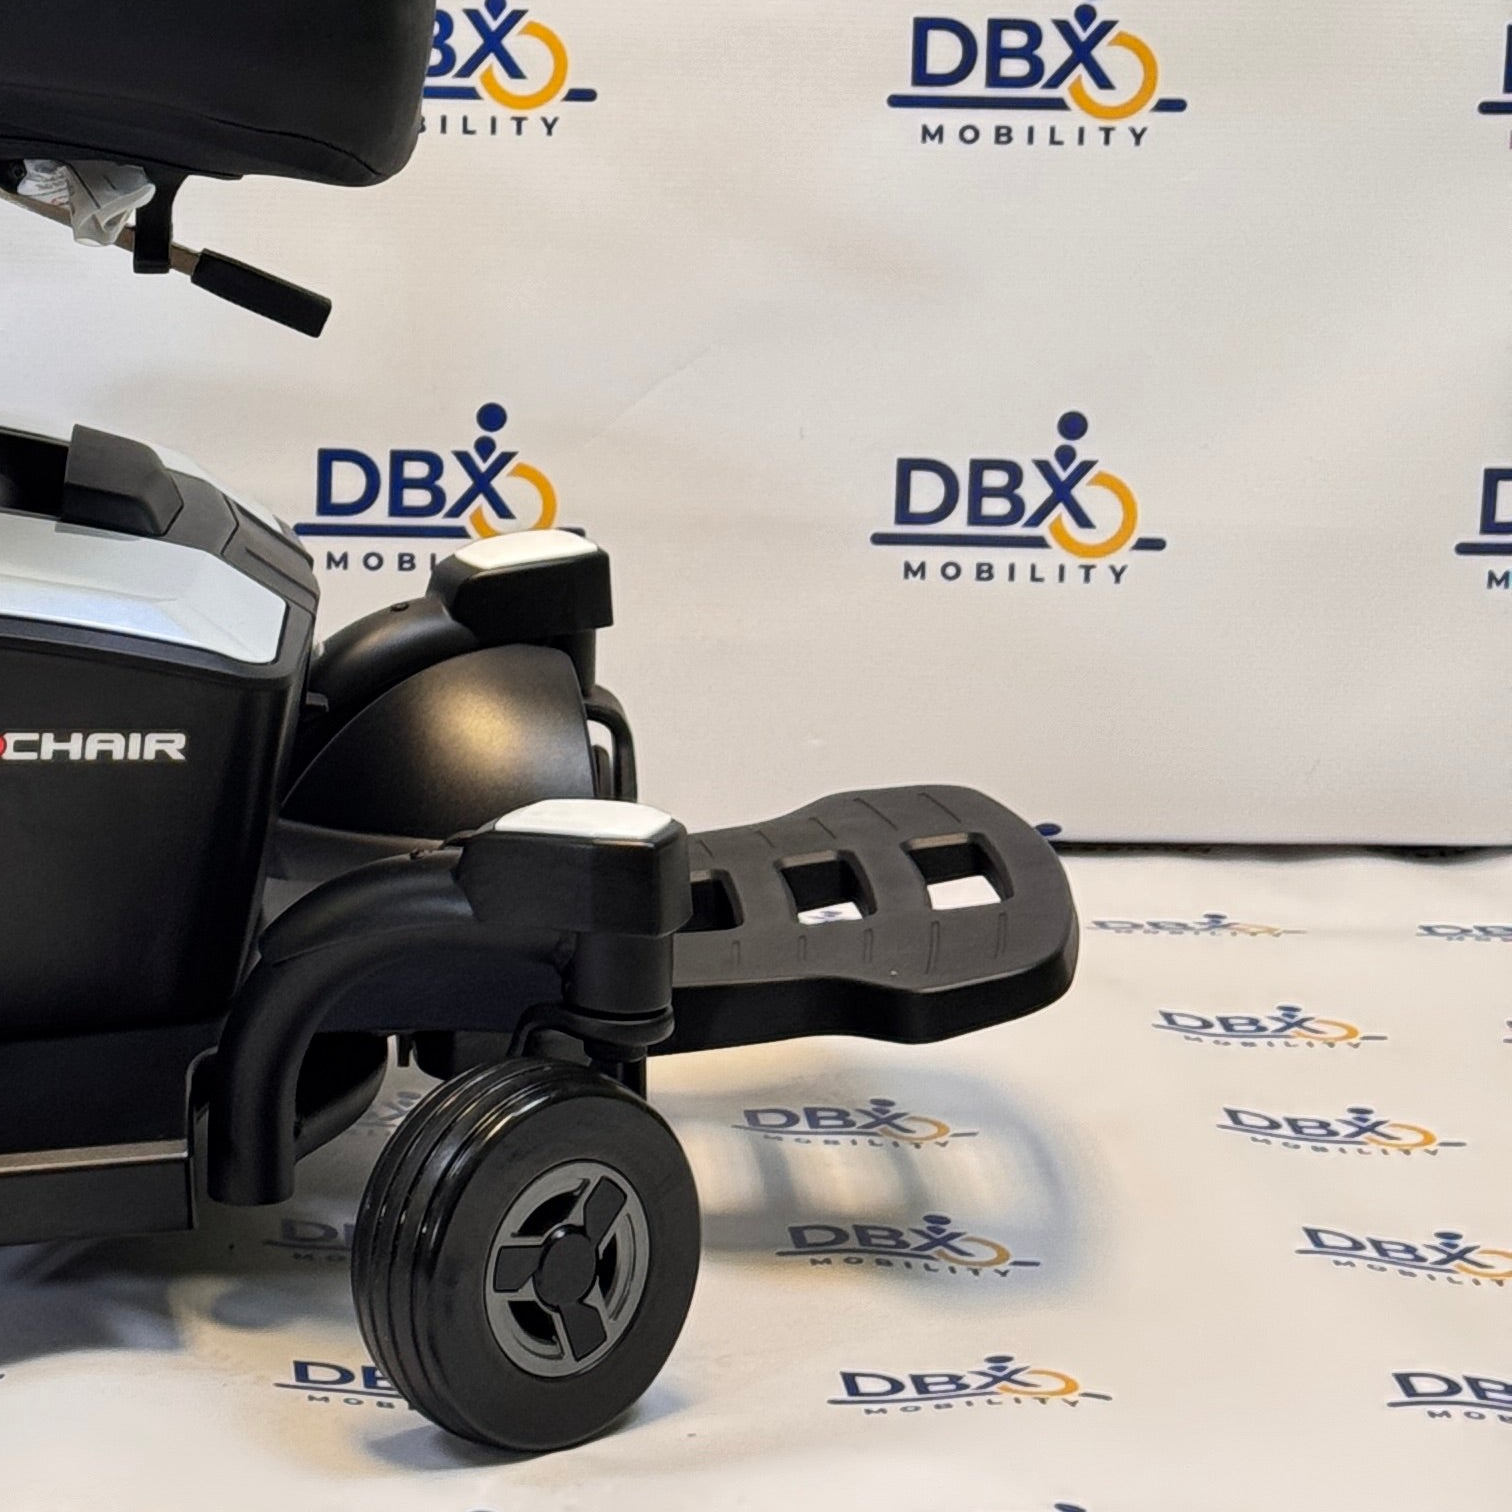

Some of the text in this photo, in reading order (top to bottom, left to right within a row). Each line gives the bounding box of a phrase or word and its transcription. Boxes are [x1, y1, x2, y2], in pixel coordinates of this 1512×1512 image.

[911, 17, 1119, 90] DBX
[419, 115, 559, 136] ILITY
[921, 124, 1148, 148] MOBILITY
[316, 448, 519, 519] DBX
[894, 457, 1099, 530] DBX
[326, 551, 436, 571] MOBI
[904, 561, 1128, 584] MOBILITY
[1159, 1009, 1326, 1035] DBX
[744, 1107, 917, 1134] DBX
[1223, 1107, 1401, 1140] DBX
[788, 1224, 975, 1257] DBX
[1302, 1226, 1495, 1269] DBX
[1333, 1260, 1504, 1287] MOBILIT
[839, 1372, 1044, 1399] DBX
[1391, 1372, 1512, 1405] DB
